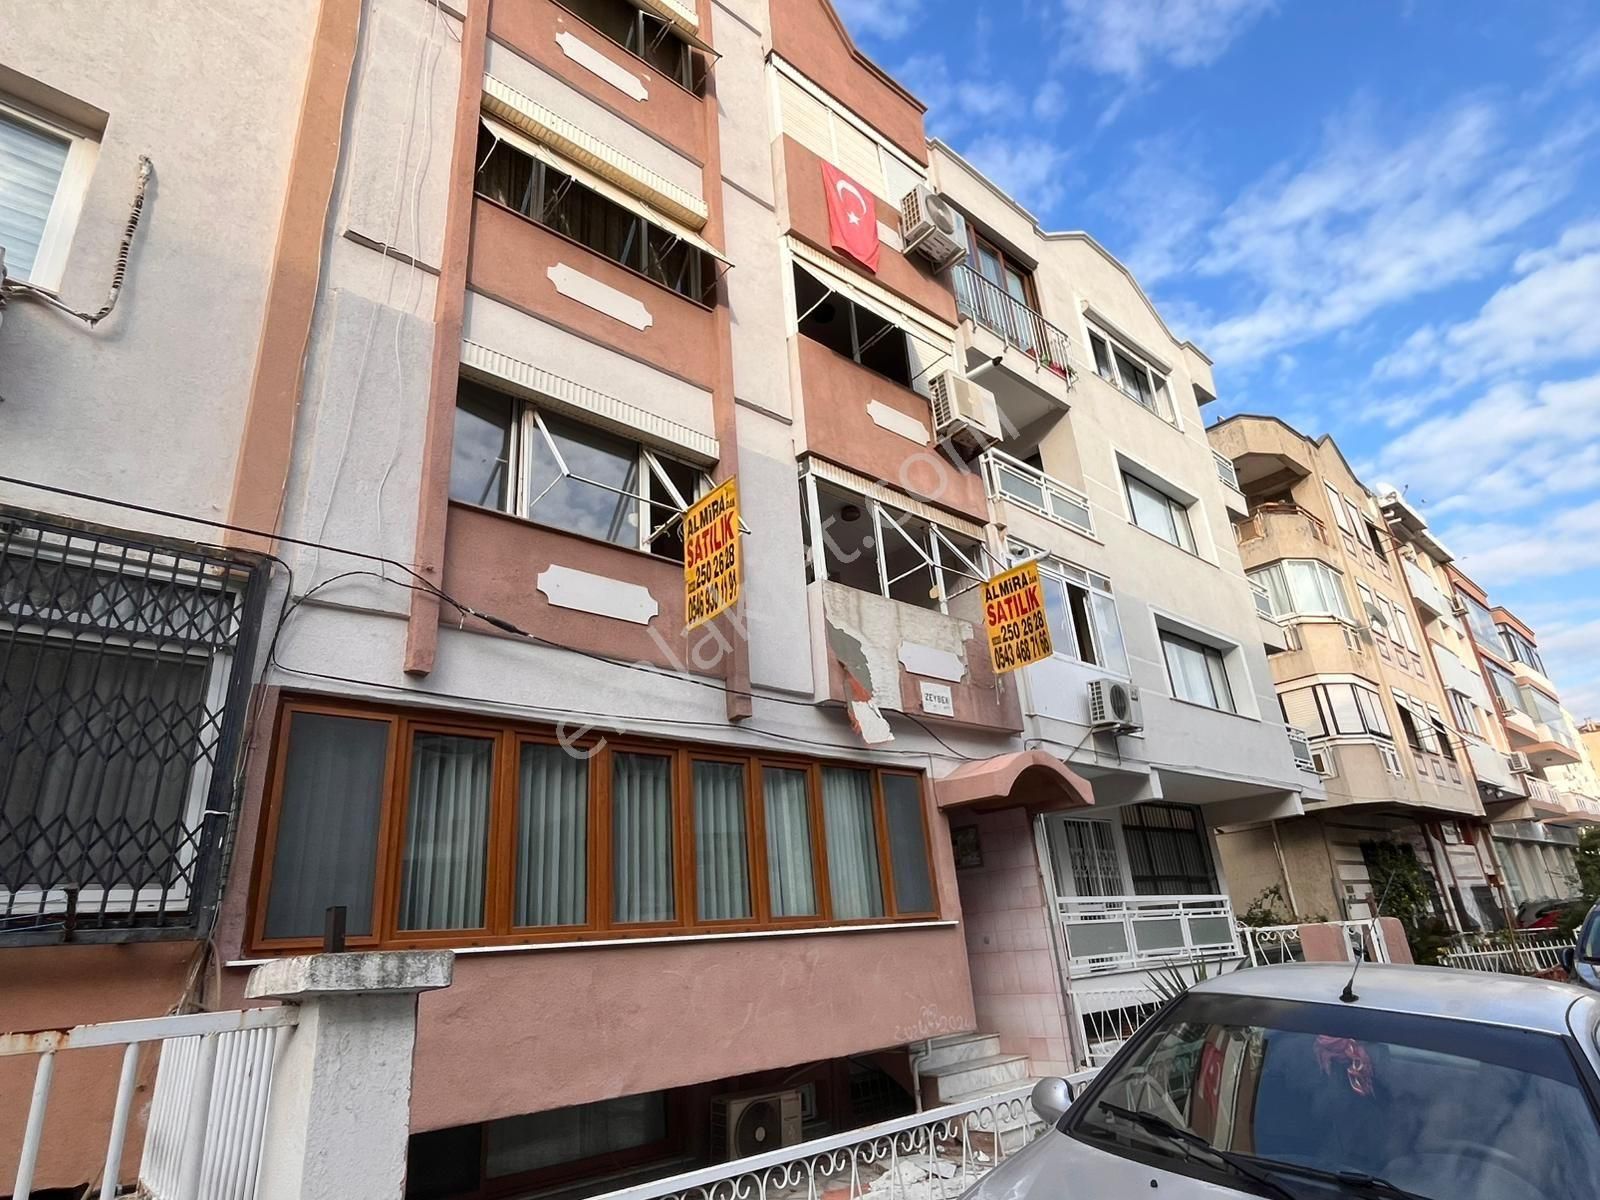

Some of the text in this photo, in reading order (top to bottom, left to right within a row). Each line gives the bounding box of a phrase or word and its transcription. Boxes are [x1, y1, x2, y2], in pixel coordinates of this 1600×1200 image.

[687, 511, 734, 569] SATILIK
[696, 560, 711, 588] 250
[713, 552, 724, 578] 26
[725, 544, 735, 570] 28
[728, 569, 737, 600] 91
[987, 586, 1040, 626] SATILIK
[1001, 621, 1020, 643] 250
[1021, 616, 1033, 636] 26
[1033, 611, 1044, 630] 28
[994, 643, 1015, 669] 0543
[1016, 638, 1031, 663] 468
[1030, 634, 1041, 658] 71
